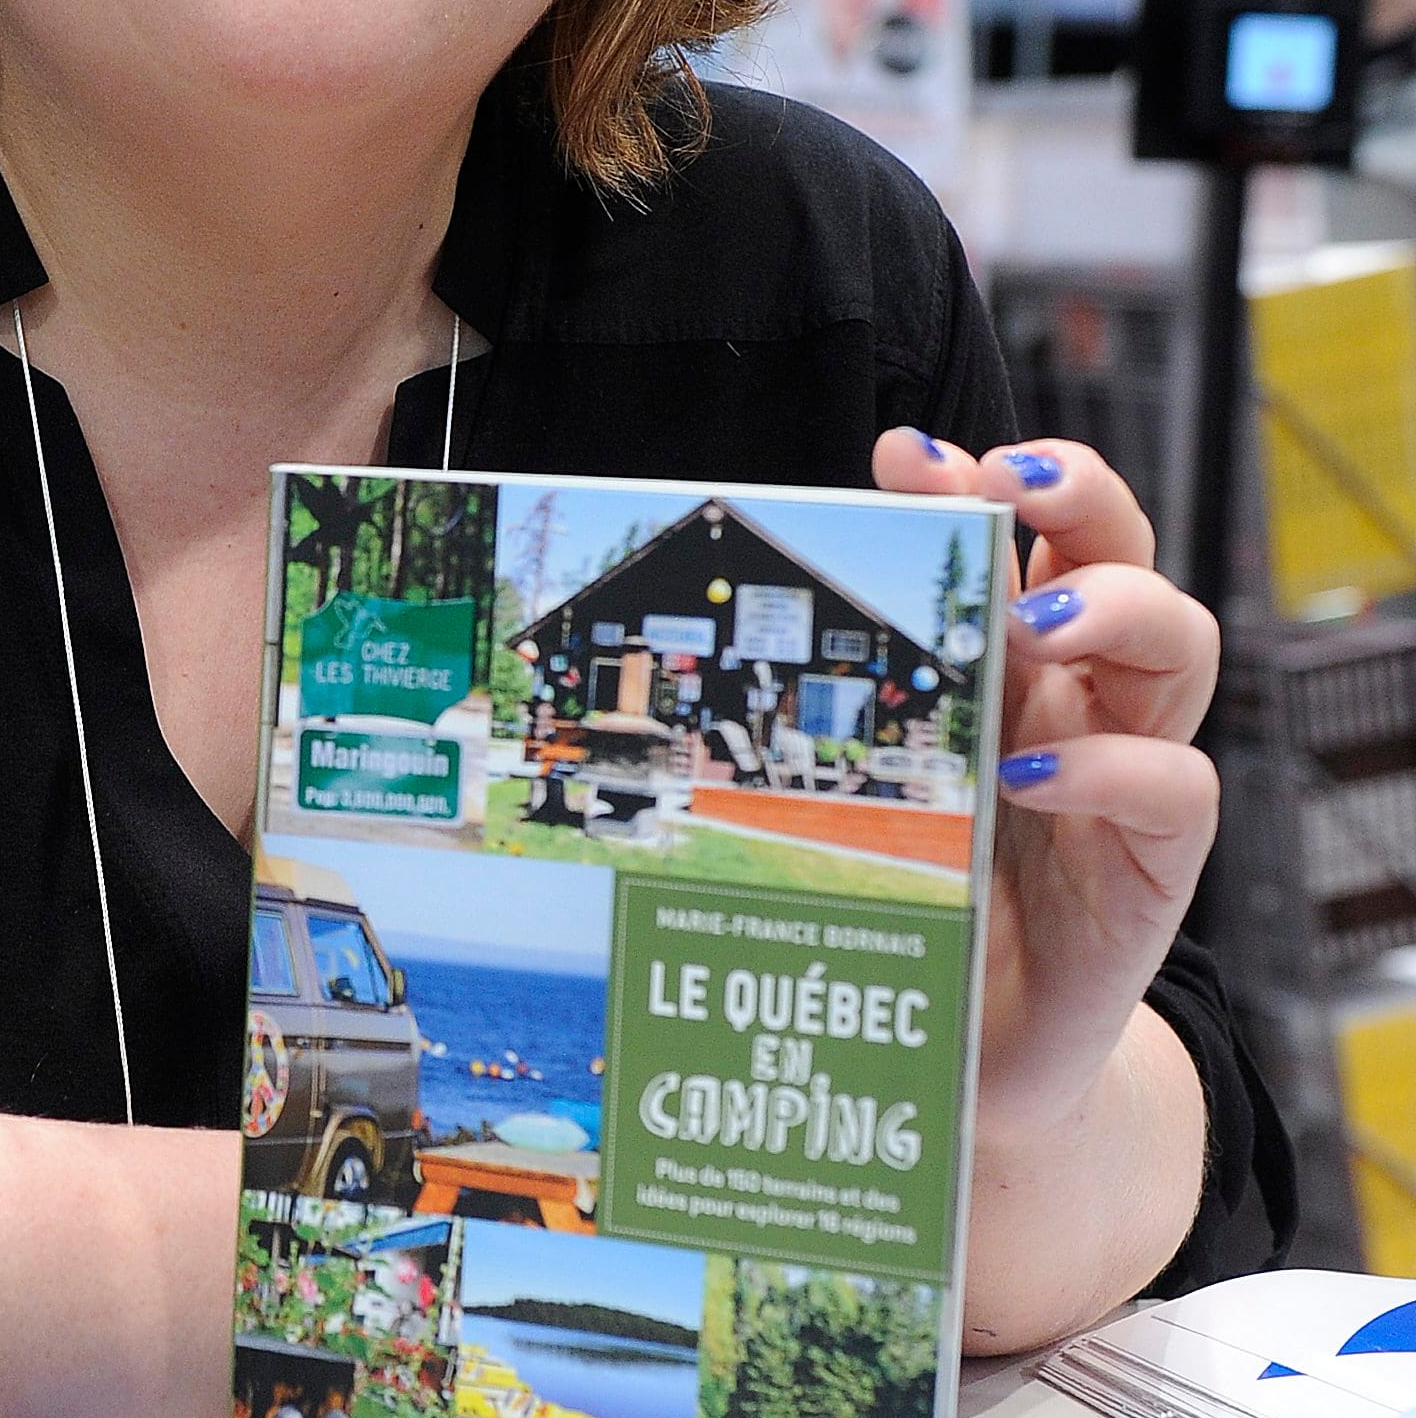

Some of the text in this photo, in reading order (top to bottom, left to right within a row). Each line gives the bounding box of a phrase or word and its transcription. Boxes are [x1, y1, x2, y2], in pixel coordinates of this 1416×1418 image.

[315, 661, 354, 684] LES
[310, 739, 450, 780] Maringouin
[655, 906, 927, 958] MARIE-FRANCE BORNAIS
[648, 960, 930, 1048] LE QUÉBEC
[750, 1033, 814, 1086] EN
[639, 1071, 923, 1171] CAMPING
[655, 1156, 698, 1185] Plus
